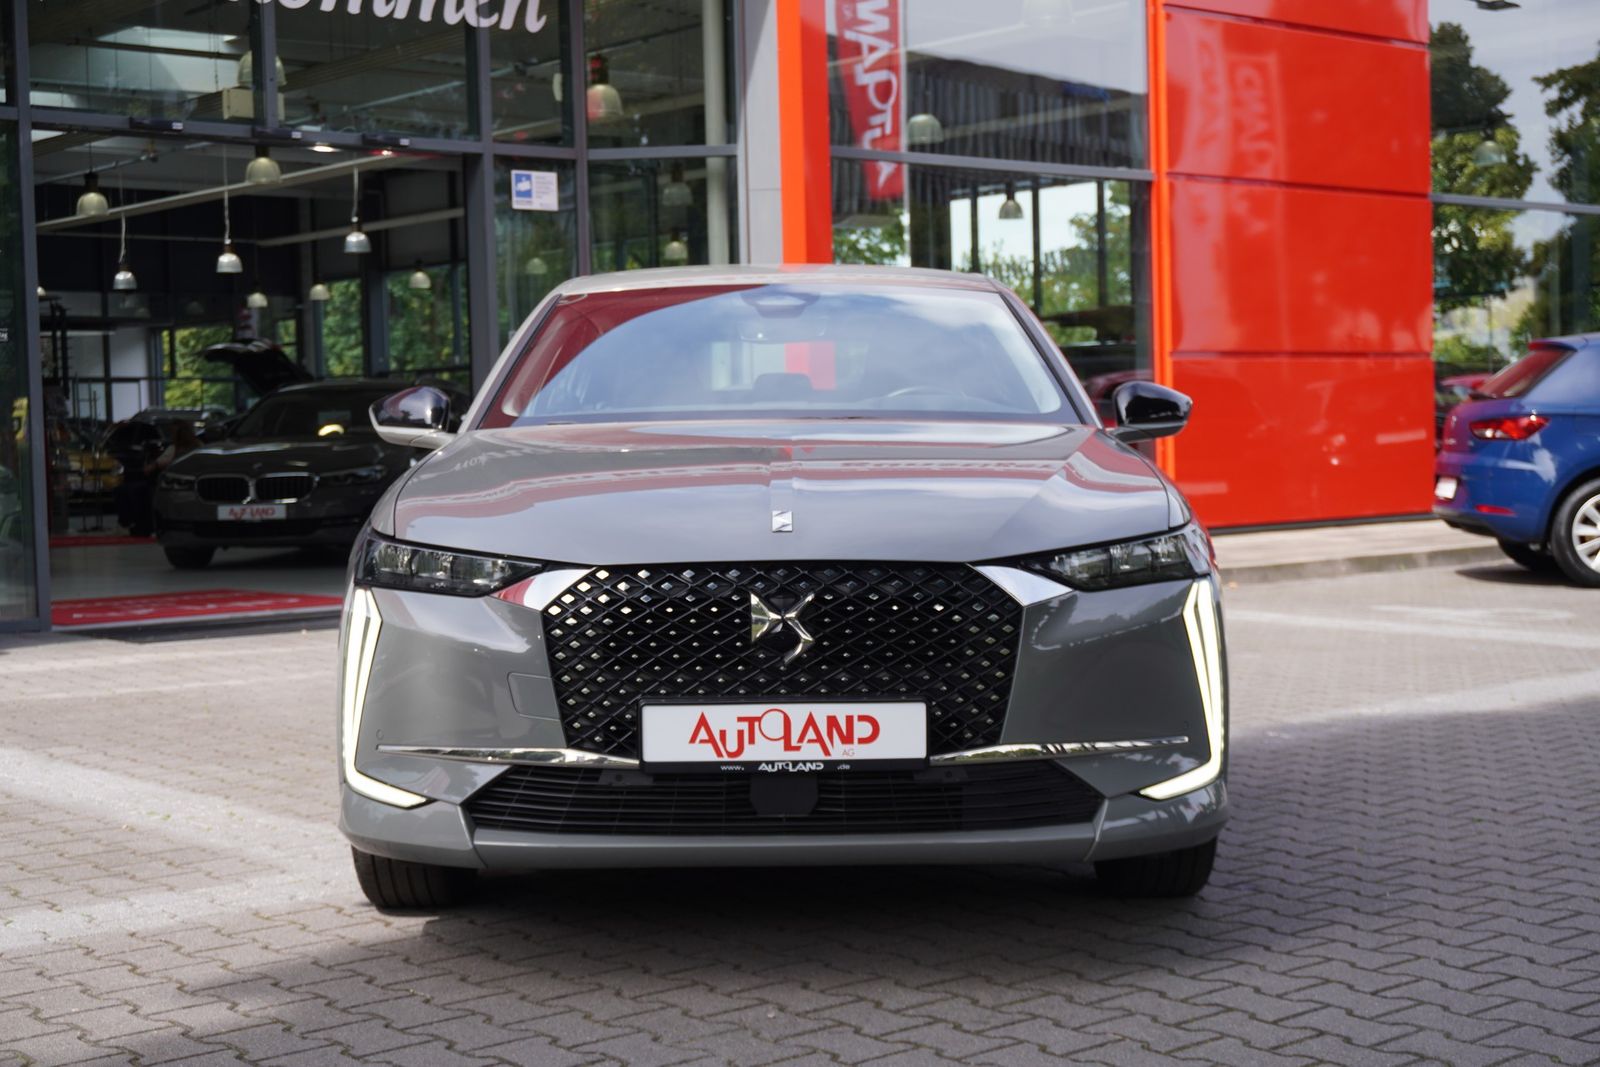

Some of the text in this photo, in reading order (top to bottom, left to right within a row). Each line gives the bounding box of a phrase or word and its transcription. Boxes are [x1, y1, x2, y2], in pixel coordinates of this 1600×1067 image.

[689, 708, 881, 759] AUTOLAND
[841, 749, 856, 757] AG
[758, 762, 824, 772] AUTOLAND
